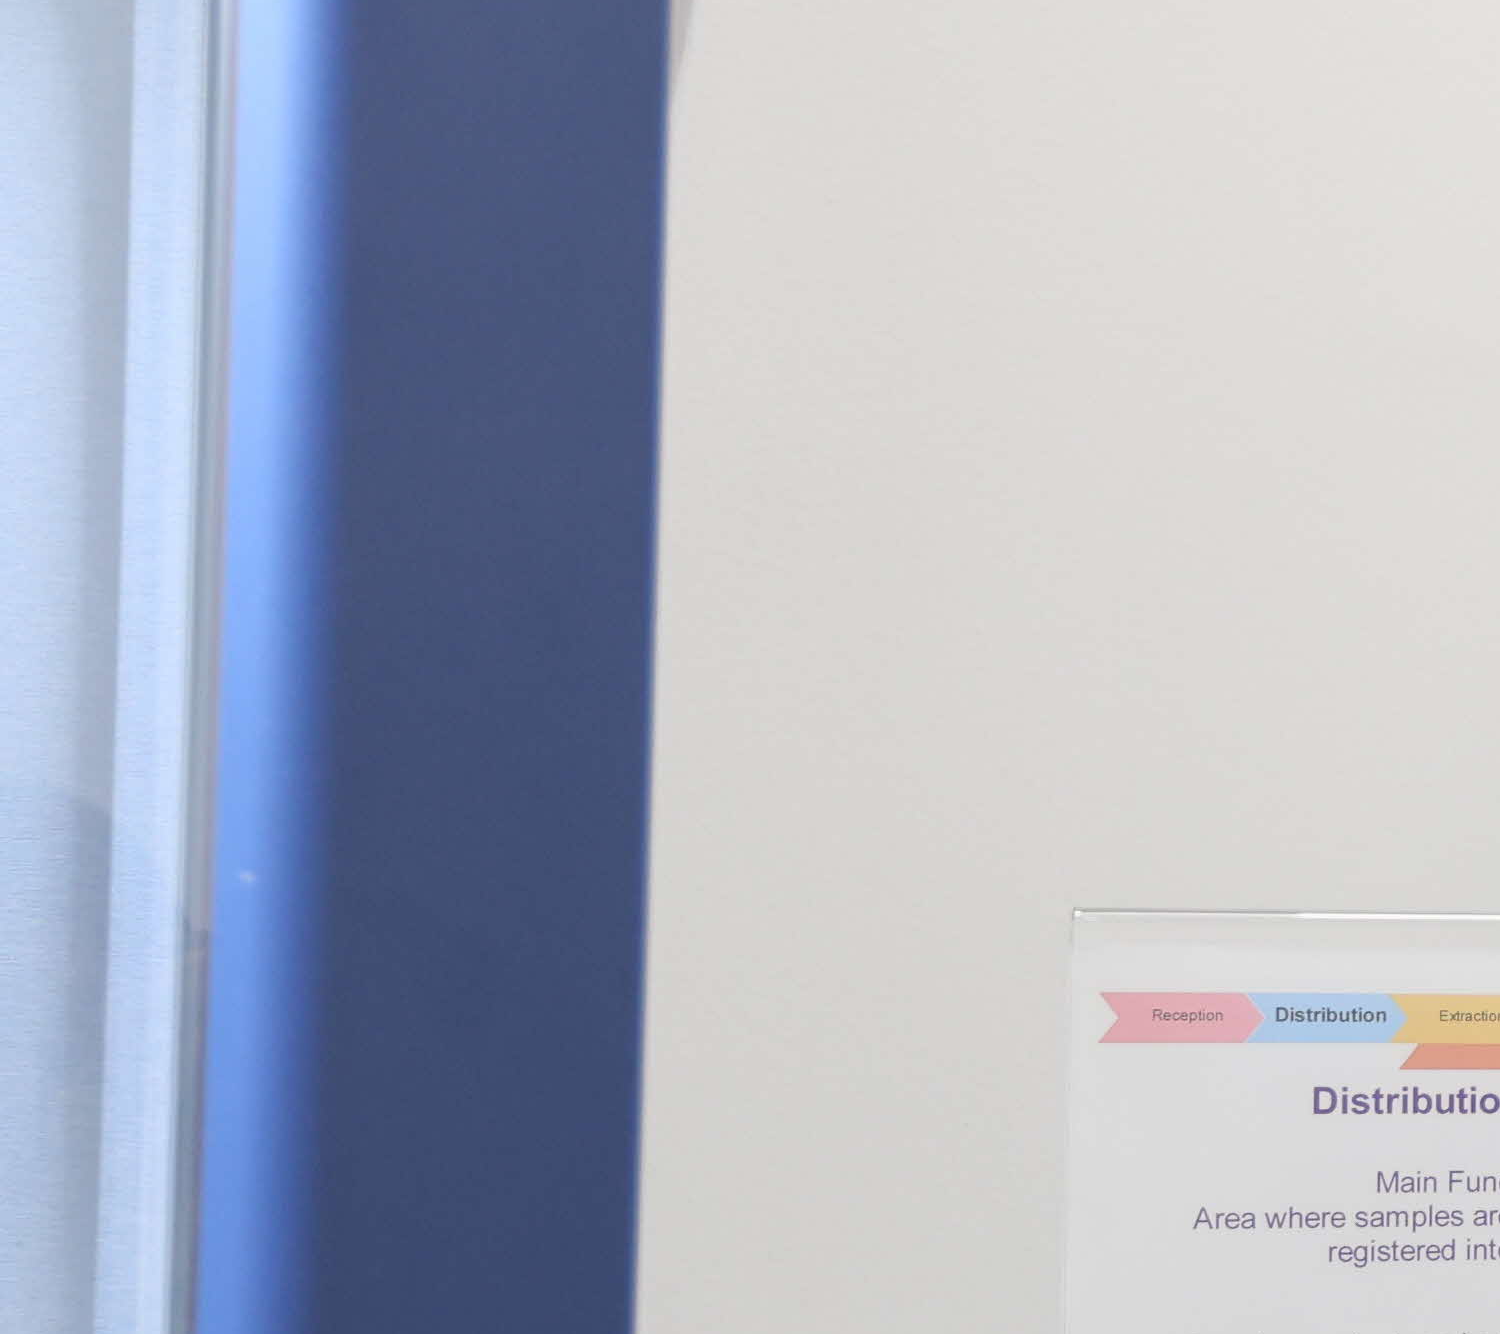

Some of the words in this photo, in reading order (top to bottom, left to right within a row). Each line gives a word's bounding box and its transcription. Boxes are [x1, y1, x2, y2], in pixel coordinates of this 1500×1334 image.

[1151, 1008, 1224, 1025] Reception
[1275, 1006, 1387, 1024] Distribution
[1376, 1170, 1438, 1194] Main
[1192, 1206, 1257, 1230] Area
[1264, 1206, 1347, 1230] where
[1354, 1204, 1465, 1234] samples
[1328, 1238, 1456, 1269] registered
